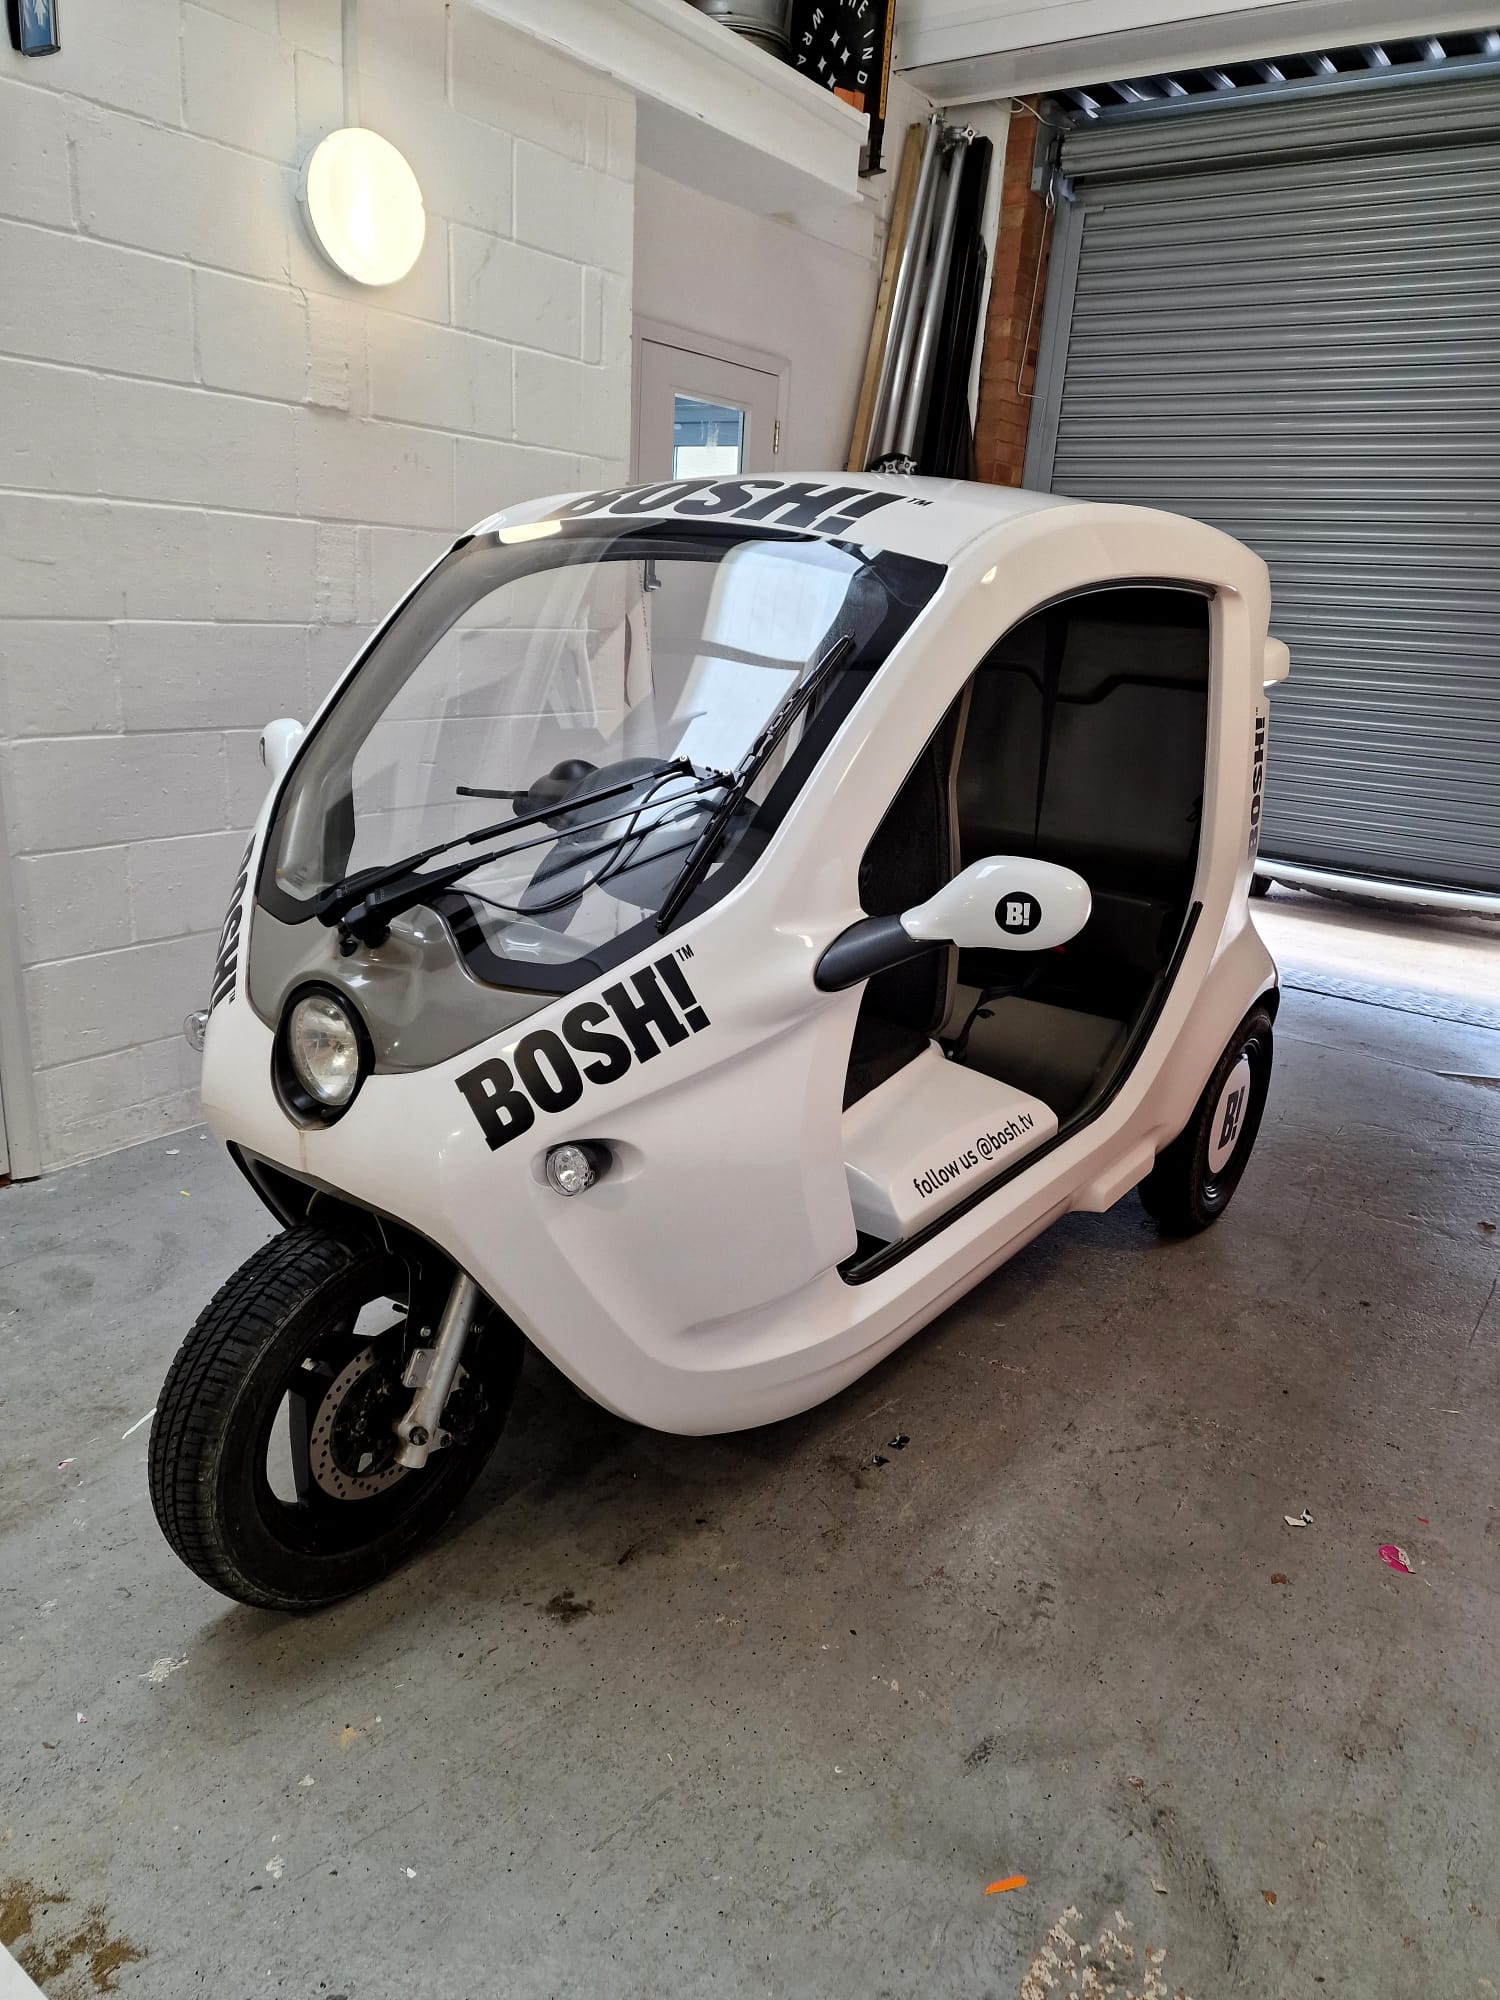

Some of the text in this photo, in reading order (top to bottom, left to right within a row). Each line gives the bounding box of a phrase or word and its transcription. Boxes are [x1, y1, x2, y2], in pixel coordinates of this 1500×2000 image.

[538, 479, 907, 535] BOSH!
[1005, 901, 1031, 926] B!
[454, 953, 711, 1152] BOSH!
[1217, 1085, 1246, 1151] B!
[913, 1113, 1034, 1198] follow us @bosh.tv
